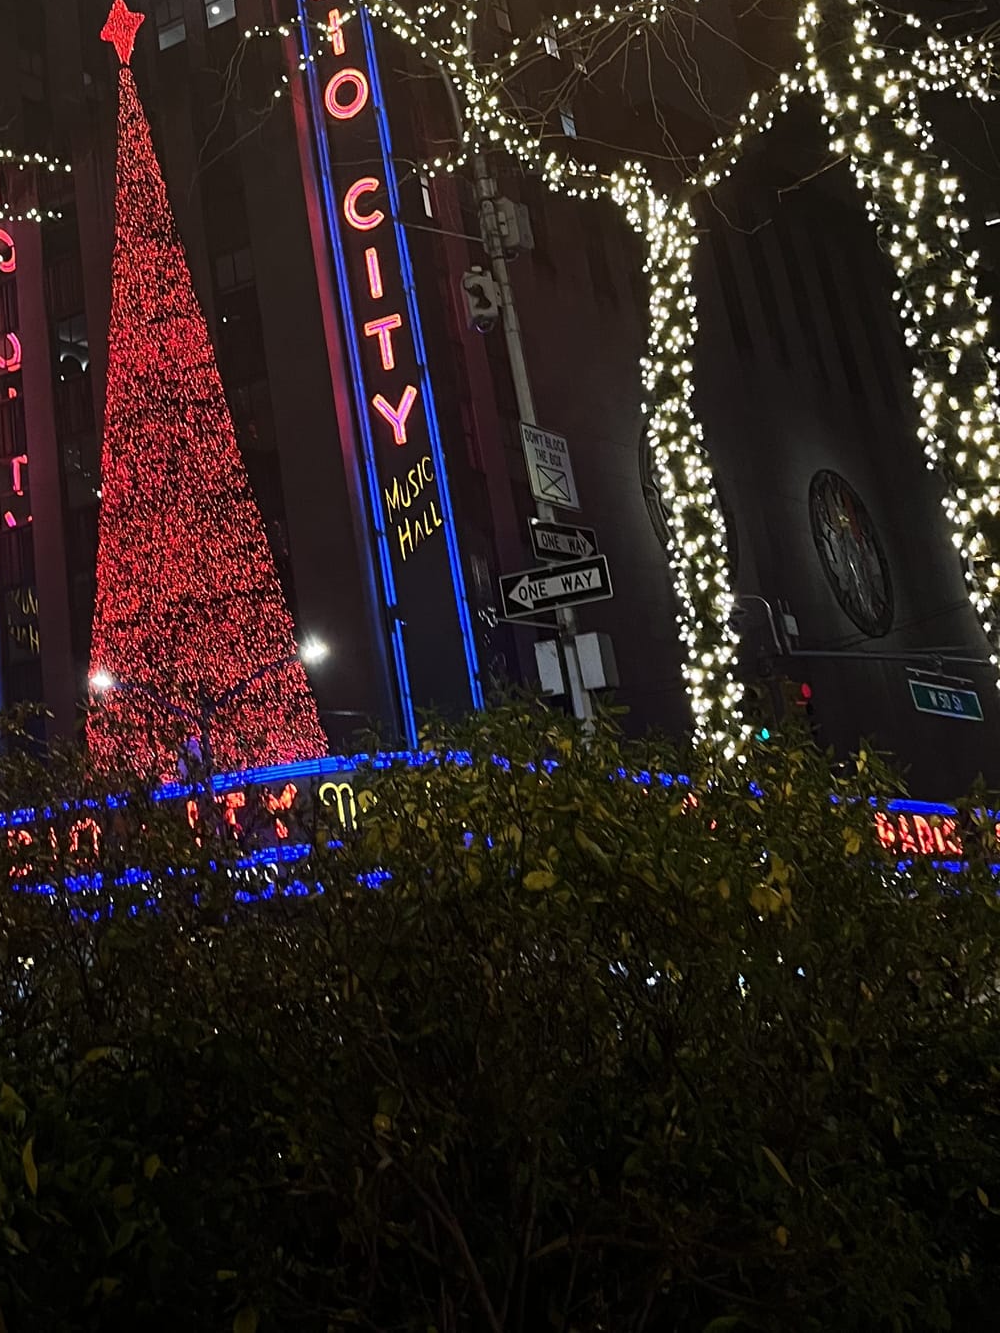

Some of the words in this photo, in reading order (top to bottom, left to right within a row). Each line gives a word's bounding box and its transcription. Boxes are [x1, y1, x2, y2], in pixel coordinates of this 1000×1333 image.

[343, 177, 418, 446] CITY
[544, 434, 567, 454] BLOCK
[535, 447, 548, 464] THE
[549, 452, 562, 467] BOX
[541, 532, 562, 550] ONE
[567, 537, 588, 557] WAY
[518, 581, 548, 602] ONE
[561, 571, 593, 593] WAY
